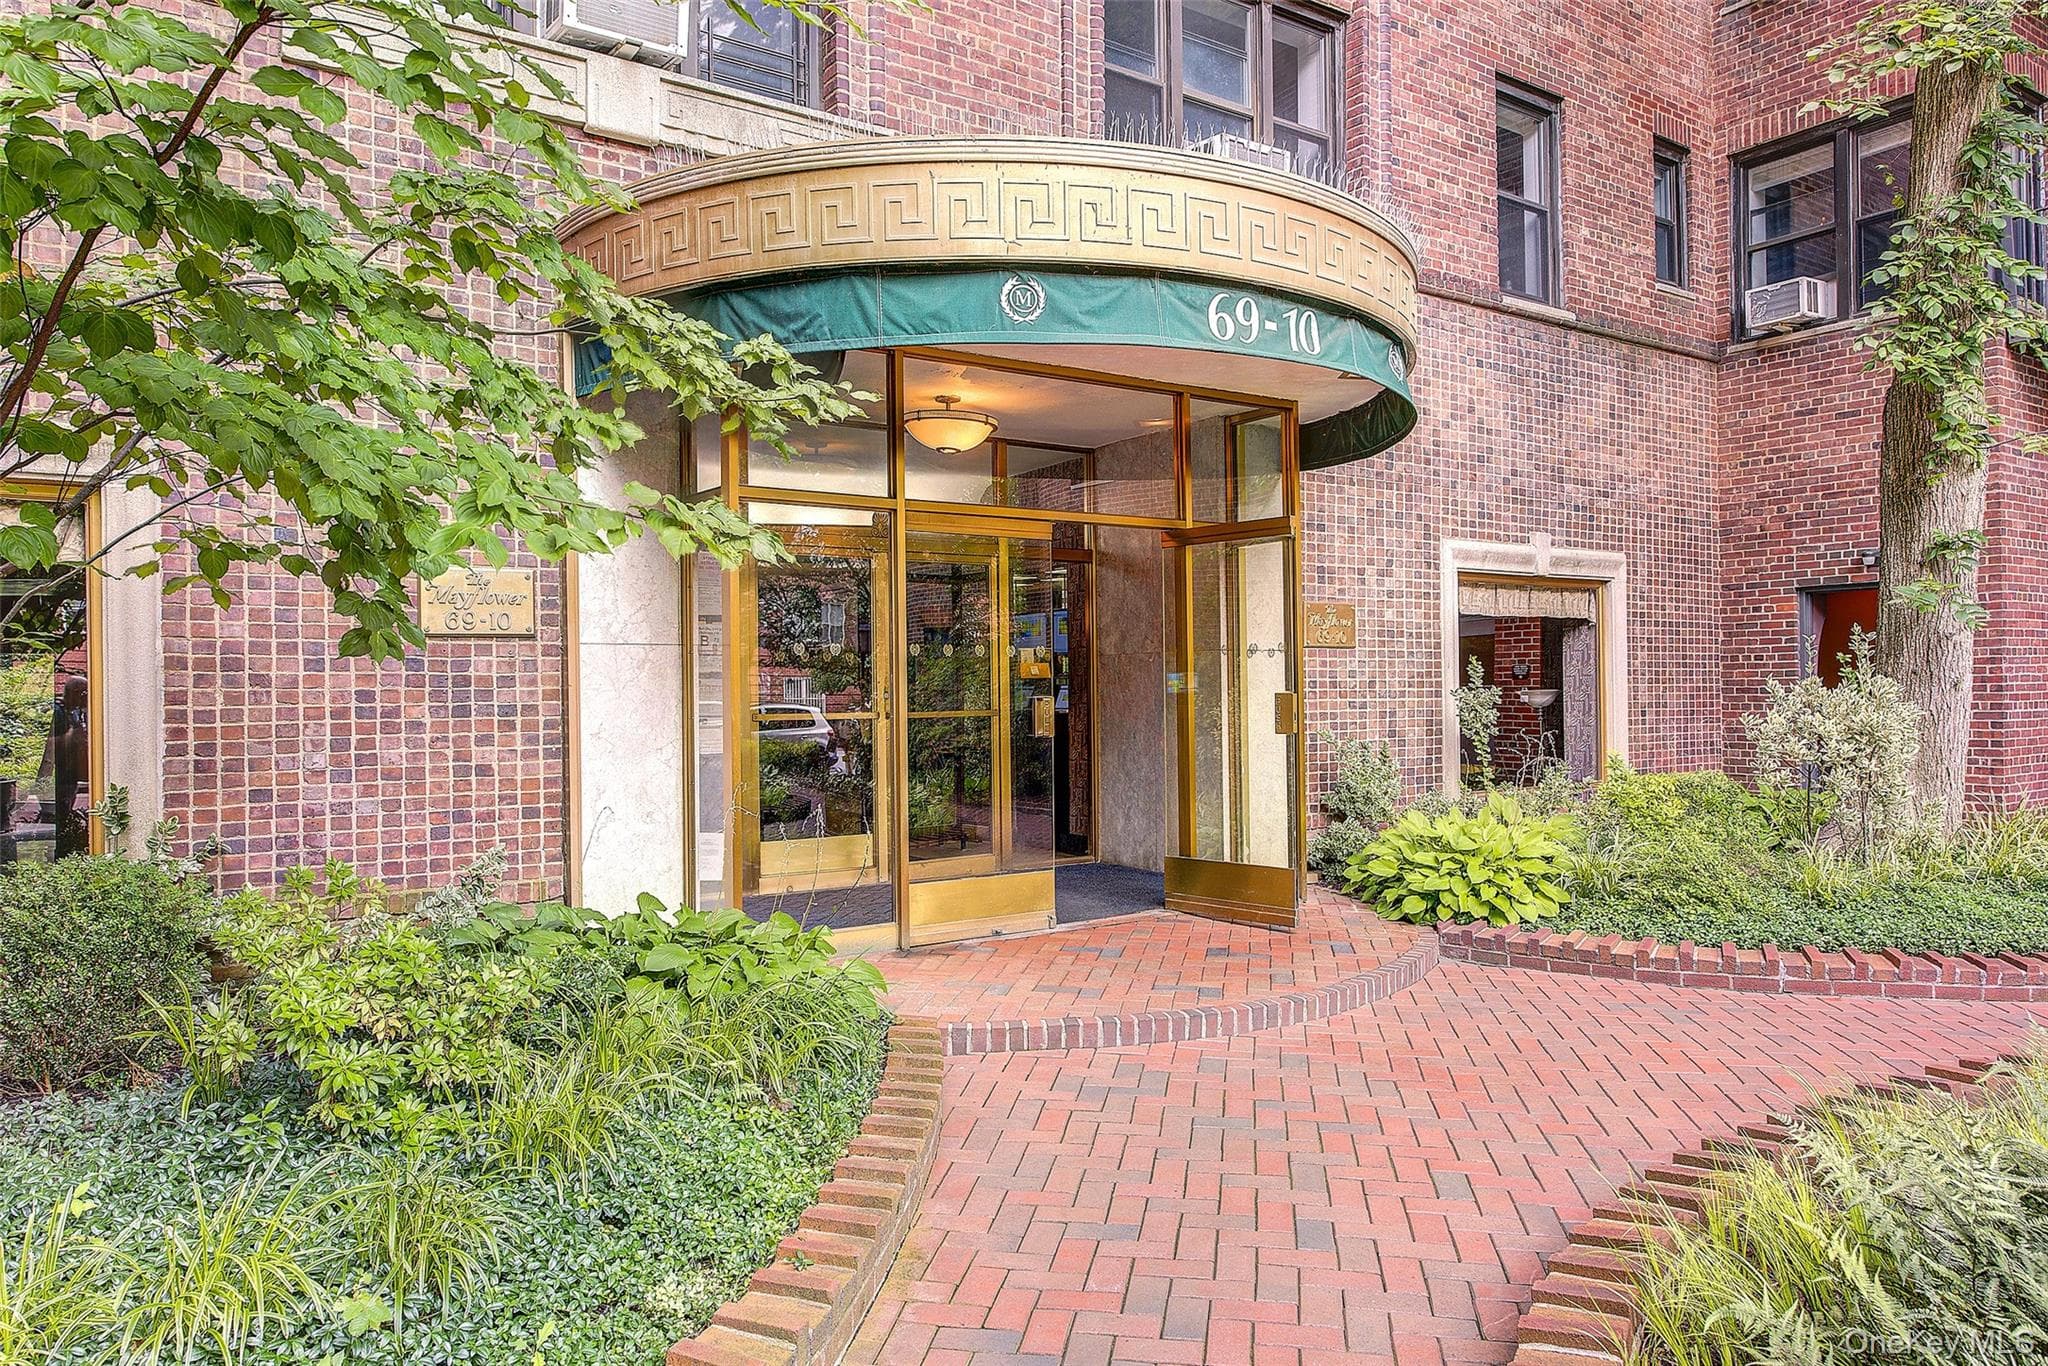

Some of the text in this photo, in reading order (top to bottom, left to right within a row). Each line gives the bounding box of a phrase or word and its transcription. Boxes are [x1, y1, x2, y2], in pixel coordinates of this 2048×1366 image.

[1015, 290, 1033, 307] M
[1207, 292, 1321, 356] 69-10
[425, 584, 528, 610] Mayflower
[445, 612, 511, 631] 69-10
